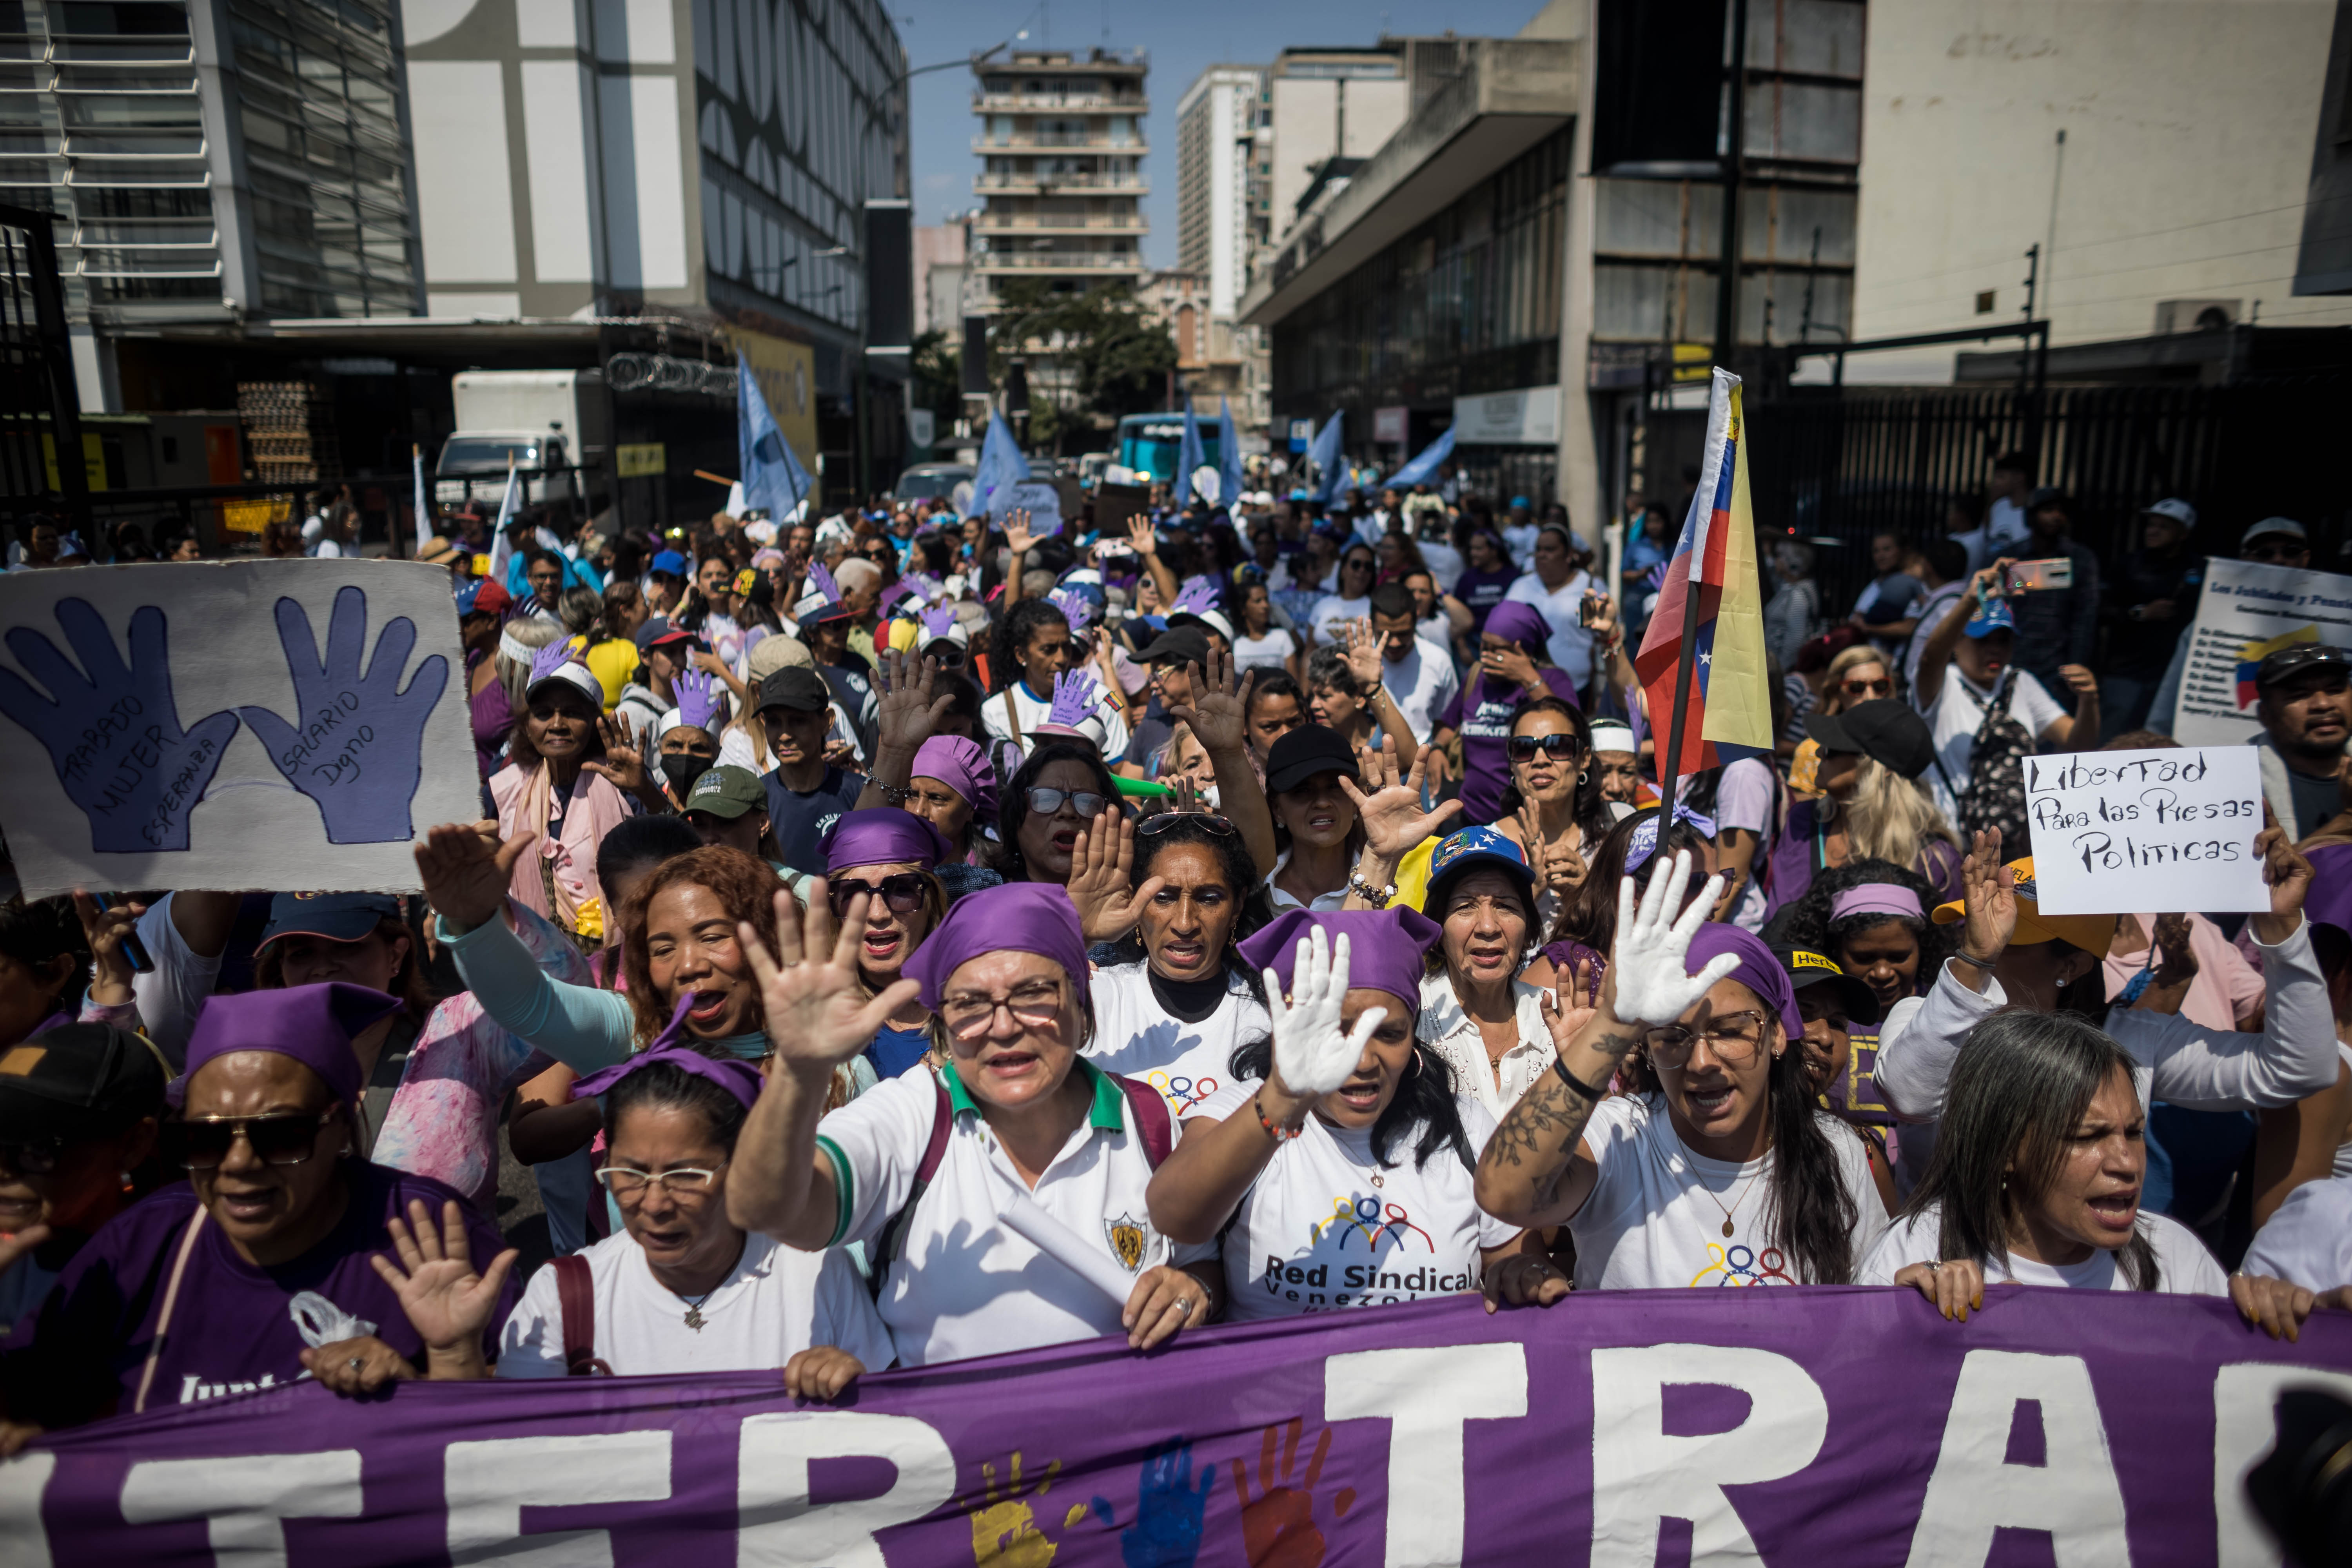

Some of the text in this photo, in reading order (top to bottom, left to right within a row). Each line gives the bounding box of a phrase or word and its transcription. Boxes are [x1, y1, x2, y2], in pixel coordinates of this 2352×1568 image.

[65, 695, 143, 782] TRABAJO
[94, 724, 178, 817] MUJER
[312, 725, 374, 786] Digno
[2098, 797, 2139, 822] las
[2140, 788, 2255, 824] Presas
[1265, 1254, 1472, 1292] Red Sindical
[0, 1411, 957, 1568] TER
